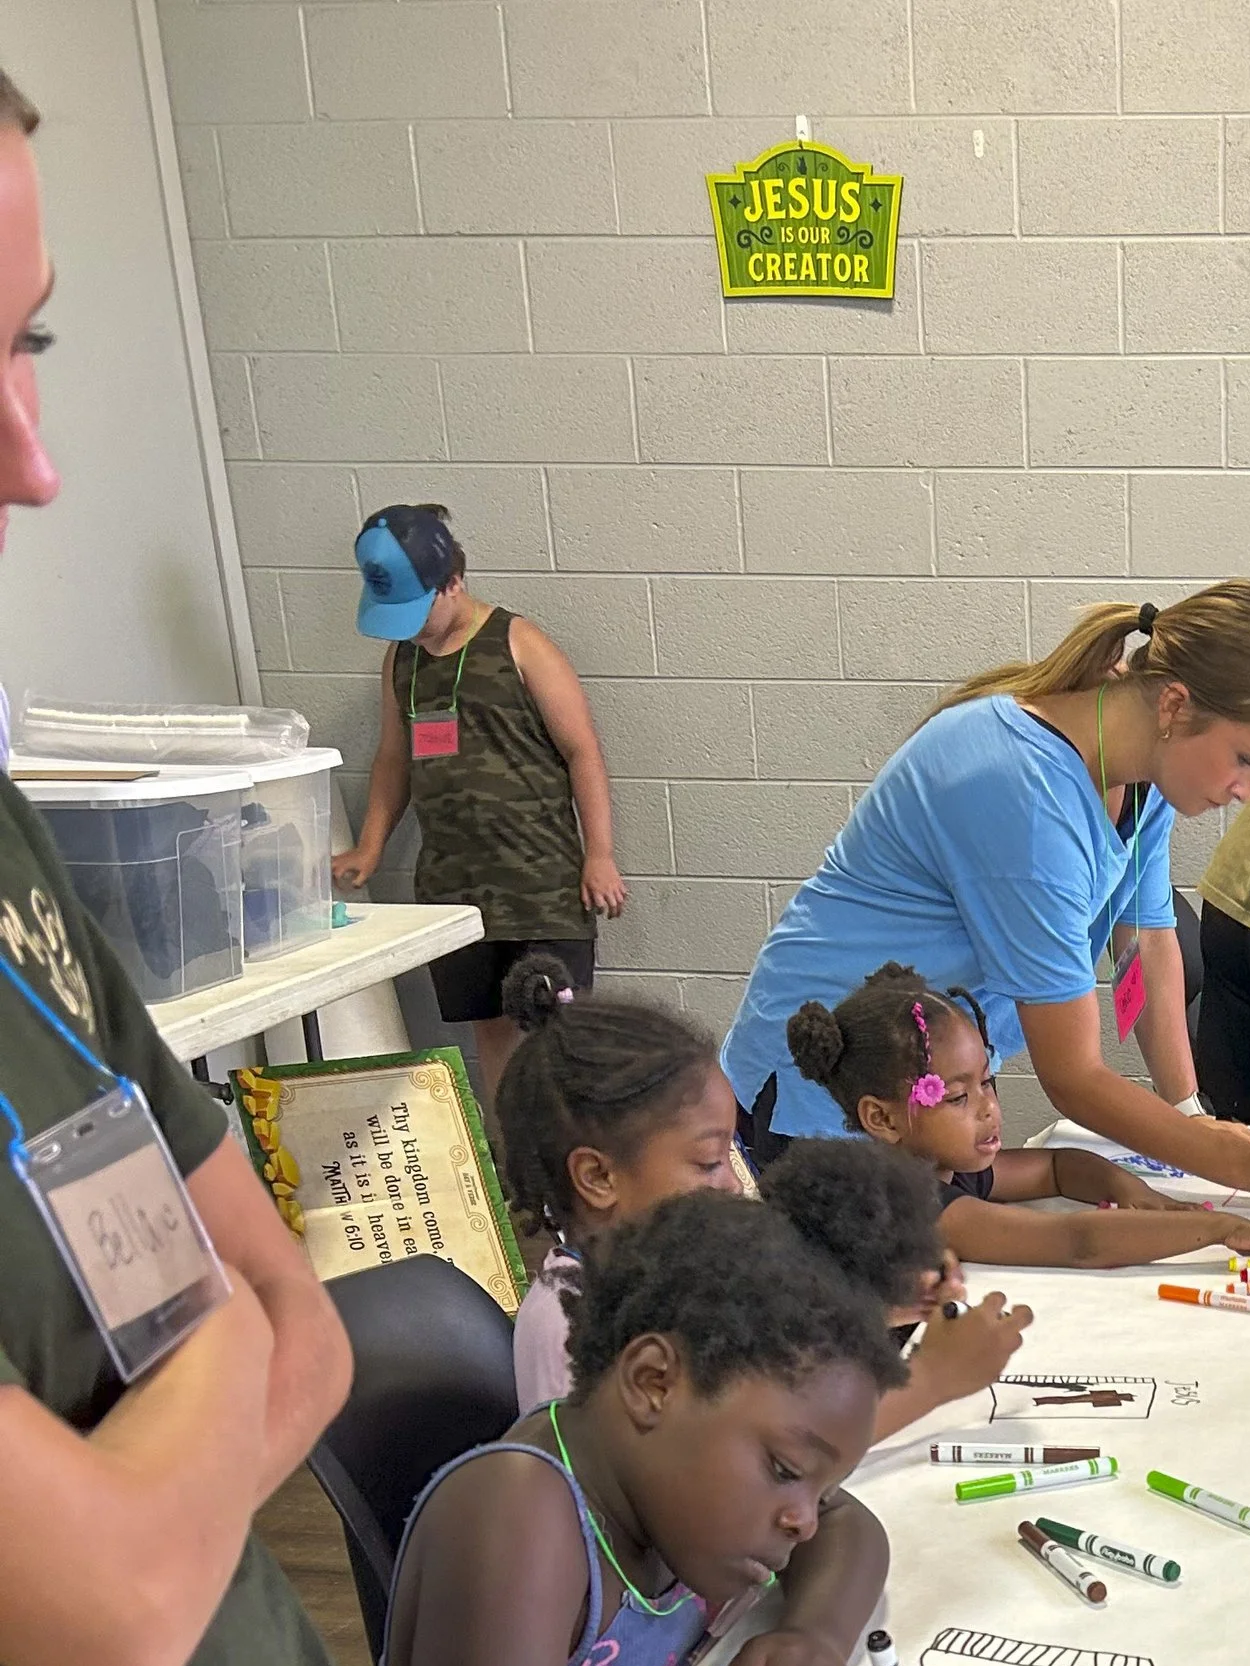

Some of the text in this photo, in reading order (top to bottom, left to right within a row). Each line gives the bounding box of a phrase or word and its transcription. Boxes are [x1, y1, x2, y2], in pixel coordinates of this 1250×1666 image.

[743, 177, 861, 223] JESUS
[780, 227, 831, 244] IS OUR
[748, 252, 870, 283] CREATOR
[366, 1114, 390, 1146] will
[343, 1131, 358, 1149] as
[349, 1154, 367, 1168] it
[377, 1151, 394, 1170] be
[355, 1173, 371, 1188] is
[391, 1102, 445, 1254] Thy kingdom come.
[384, 1175, 405, 1211] done
[396, 1216, 412, 1231] in
[344, 1224, 365, 1251] 6:10
[973, 1452, 1012, 1460] MARKERS
